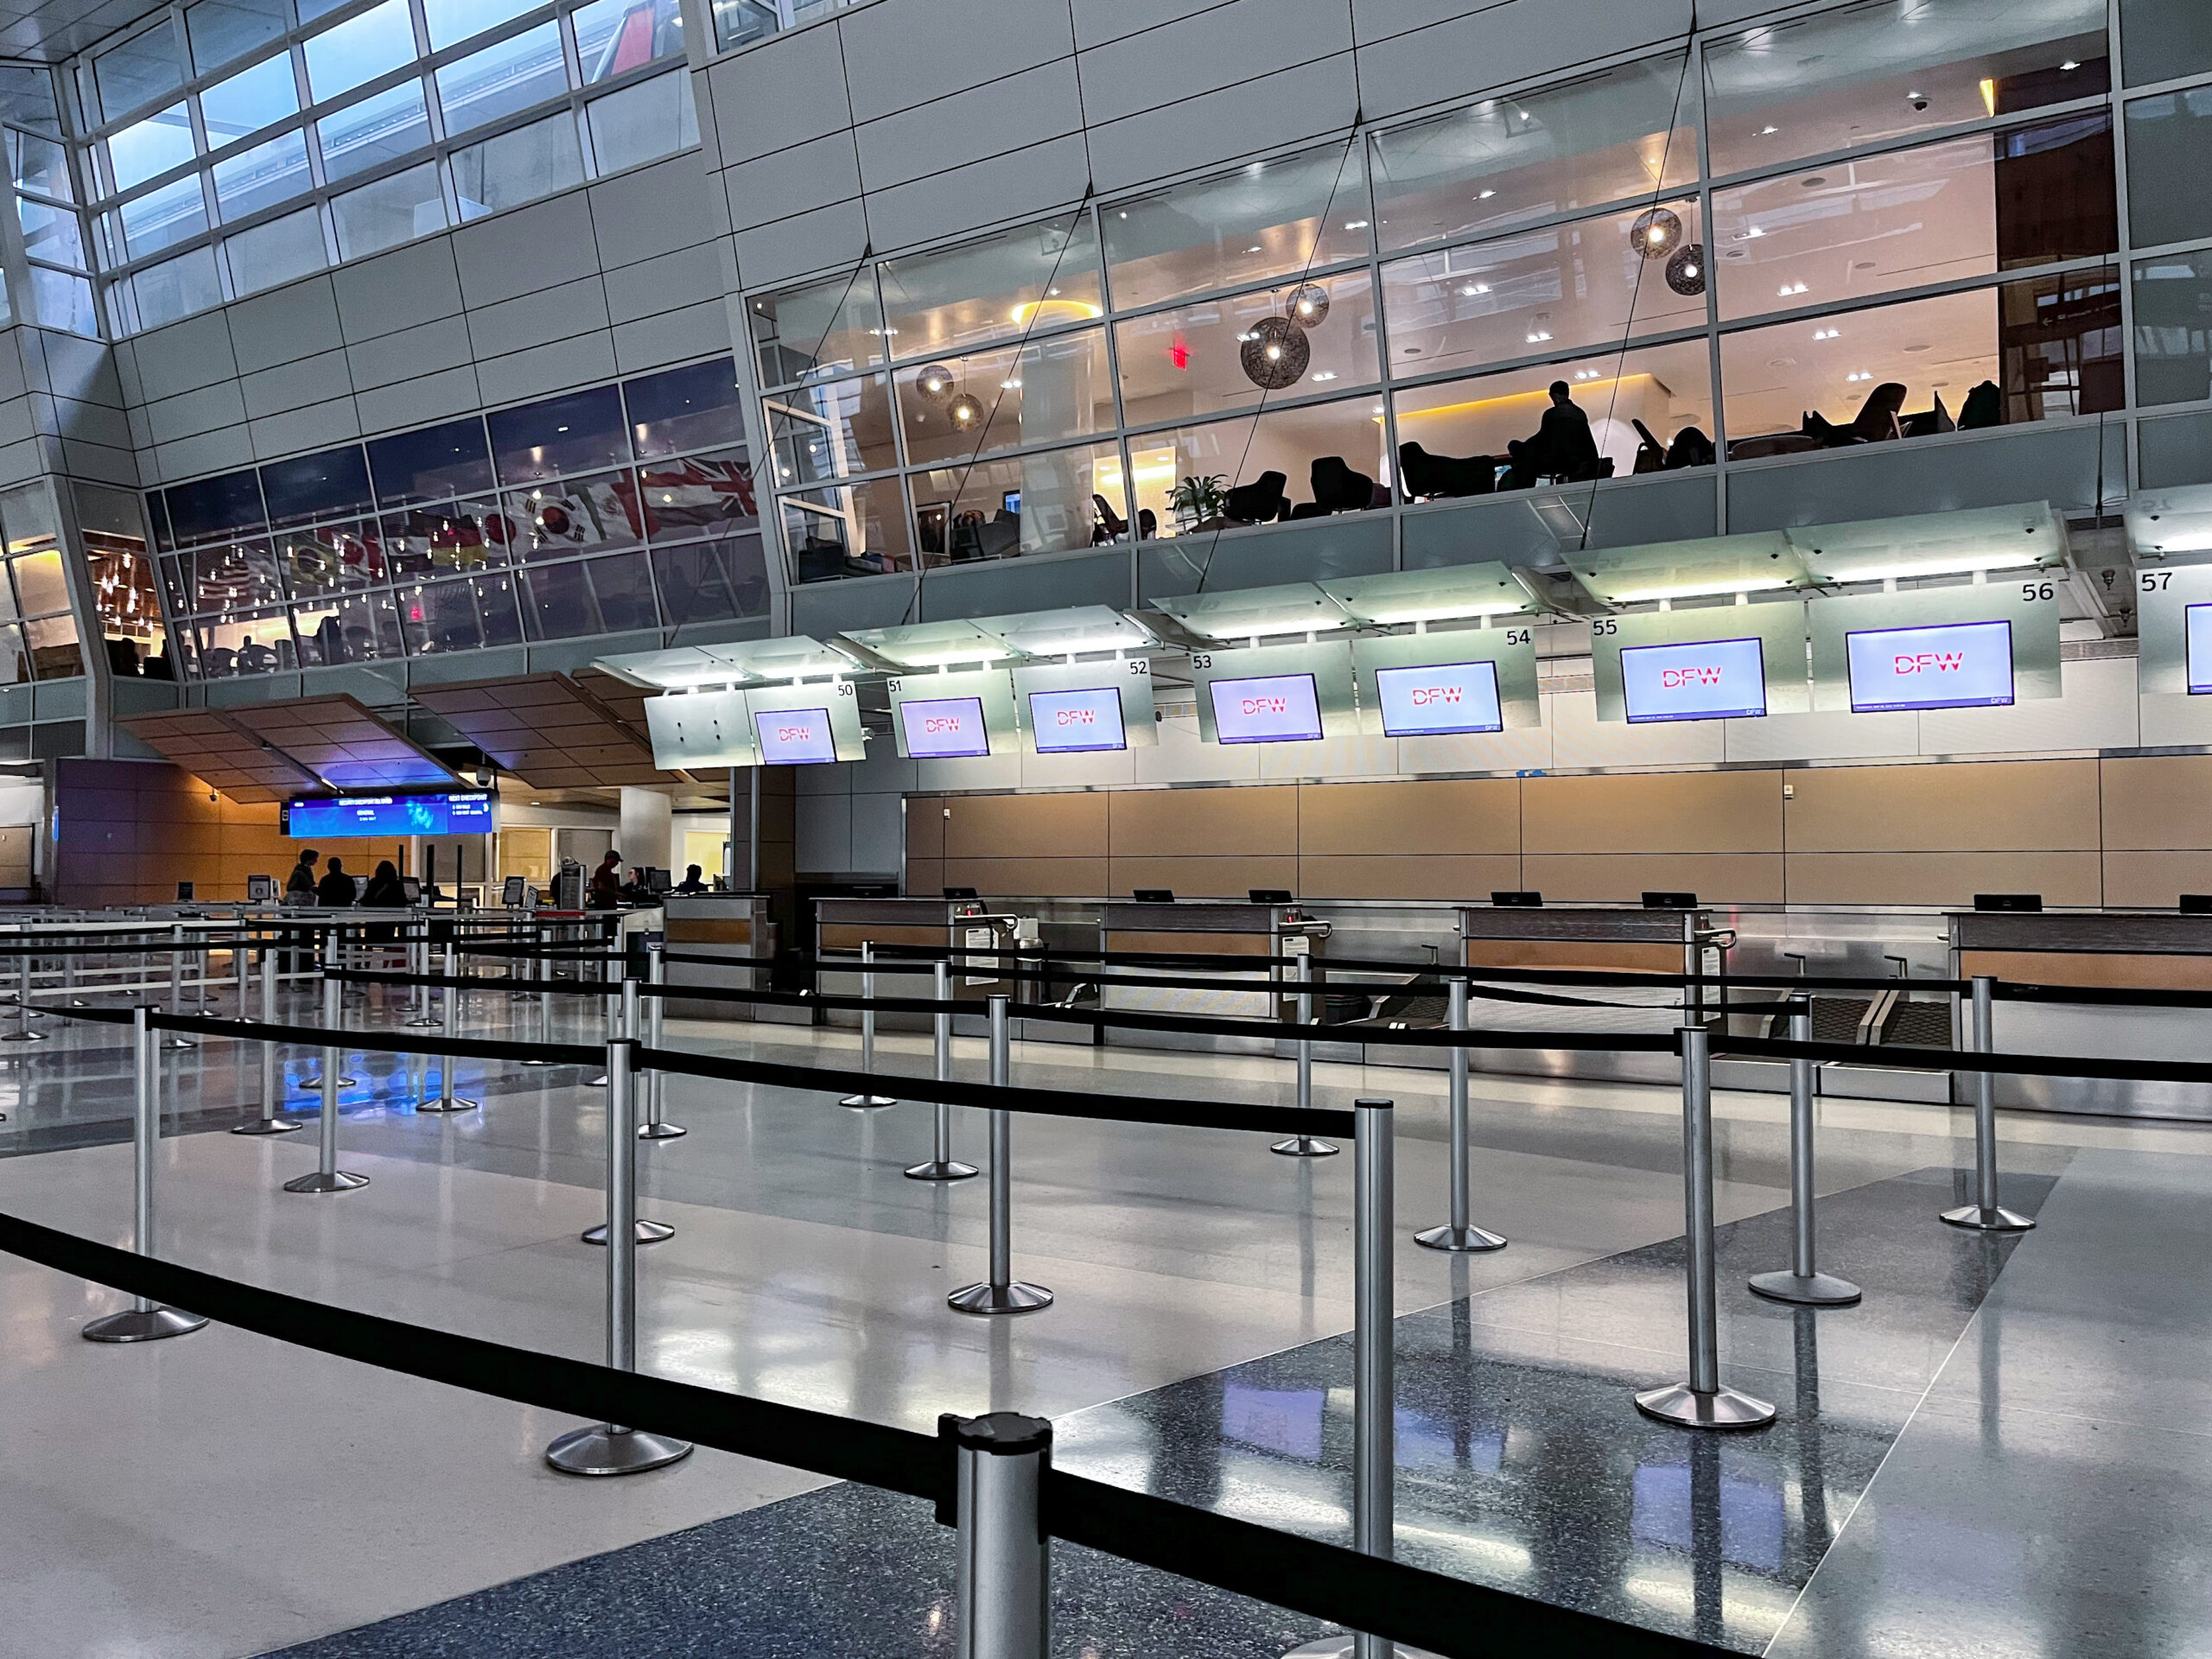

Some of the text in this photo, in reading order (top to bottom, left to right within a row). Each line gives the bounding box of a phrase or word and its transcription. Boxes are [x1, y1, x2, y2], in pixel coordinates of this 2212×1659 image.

[2141, 572, 2172, 592] 57
[2022, 582, 2054, 601] 56
[1592, 619, 1618, 636] 55
[1506, 629, 1531, 646] 54
[1129, 661, 1148, 675] 52
[1192, 654, 1212, 670] 53
[1894, 652, 1964, 675] DFW
[888, 680, 901, 693] 51
[1662, 667, 1722, 689] DFW
[837, 684, 854, 697] 50
[1412, 686, 1463, 705] DFW
[1242, 697, 1286, 715] DFW
[925, 717, 960, 734] DFW
[1057, 709, 1096, 727] DFW
[779, 727, 810, 741] DFW
